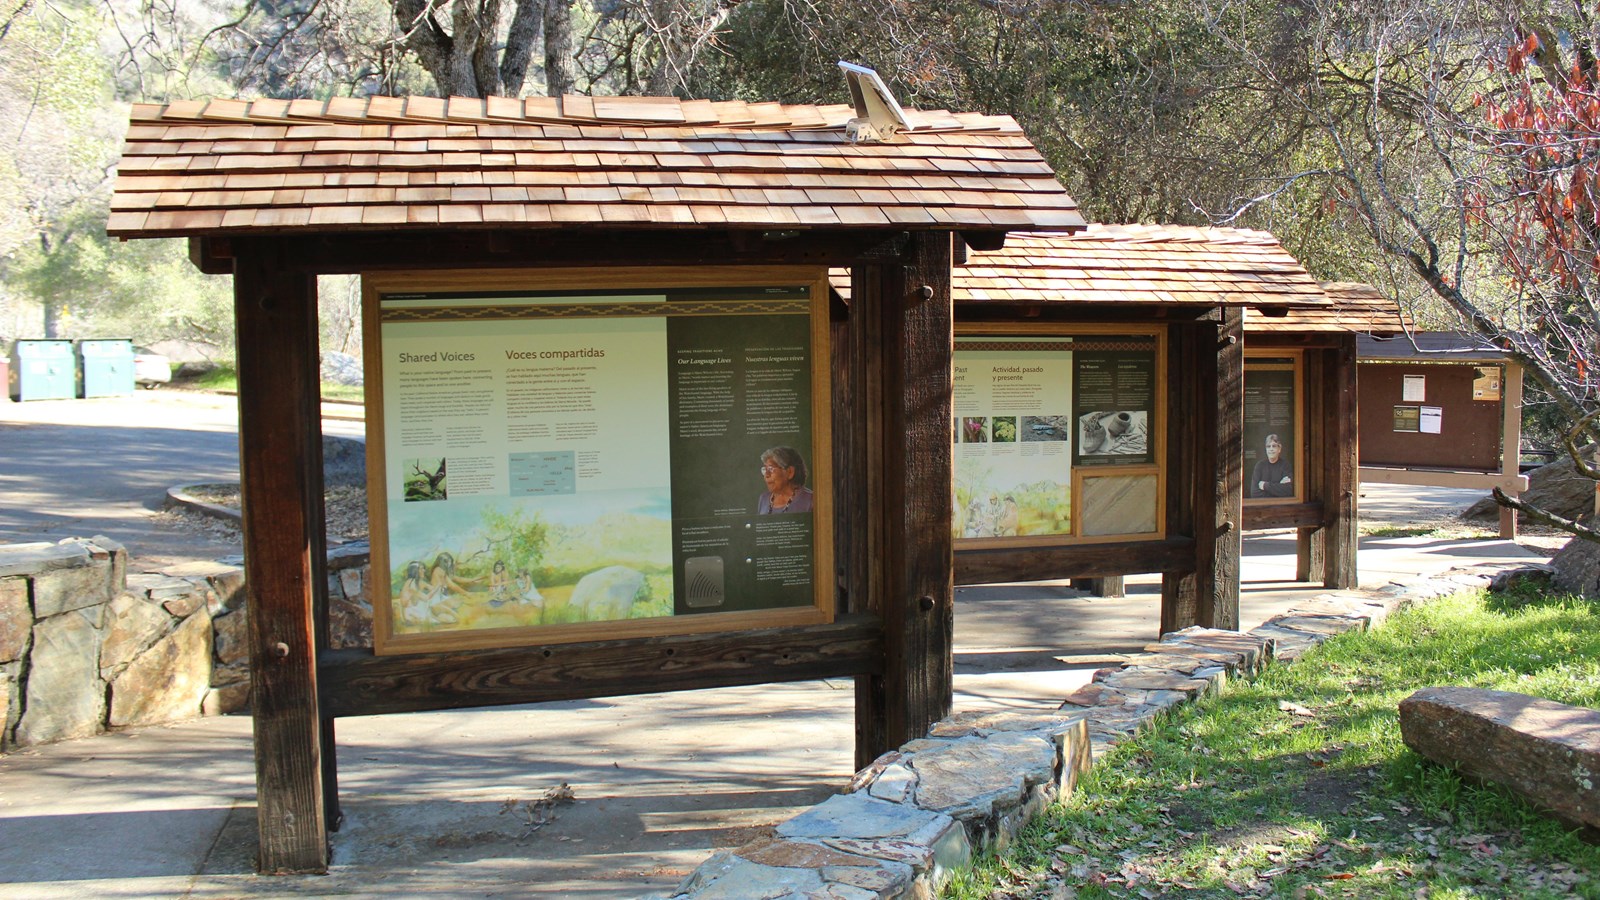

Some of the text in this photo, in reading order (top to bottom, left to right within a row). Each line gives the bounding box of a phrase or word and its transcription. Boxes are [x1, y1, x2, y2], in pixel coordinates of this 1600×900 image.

[399, 352, 476, 363] Shared Voices
[505, 347, 605, 361] Voces compartidas
[1022, 366, 1044, 374] pasado
